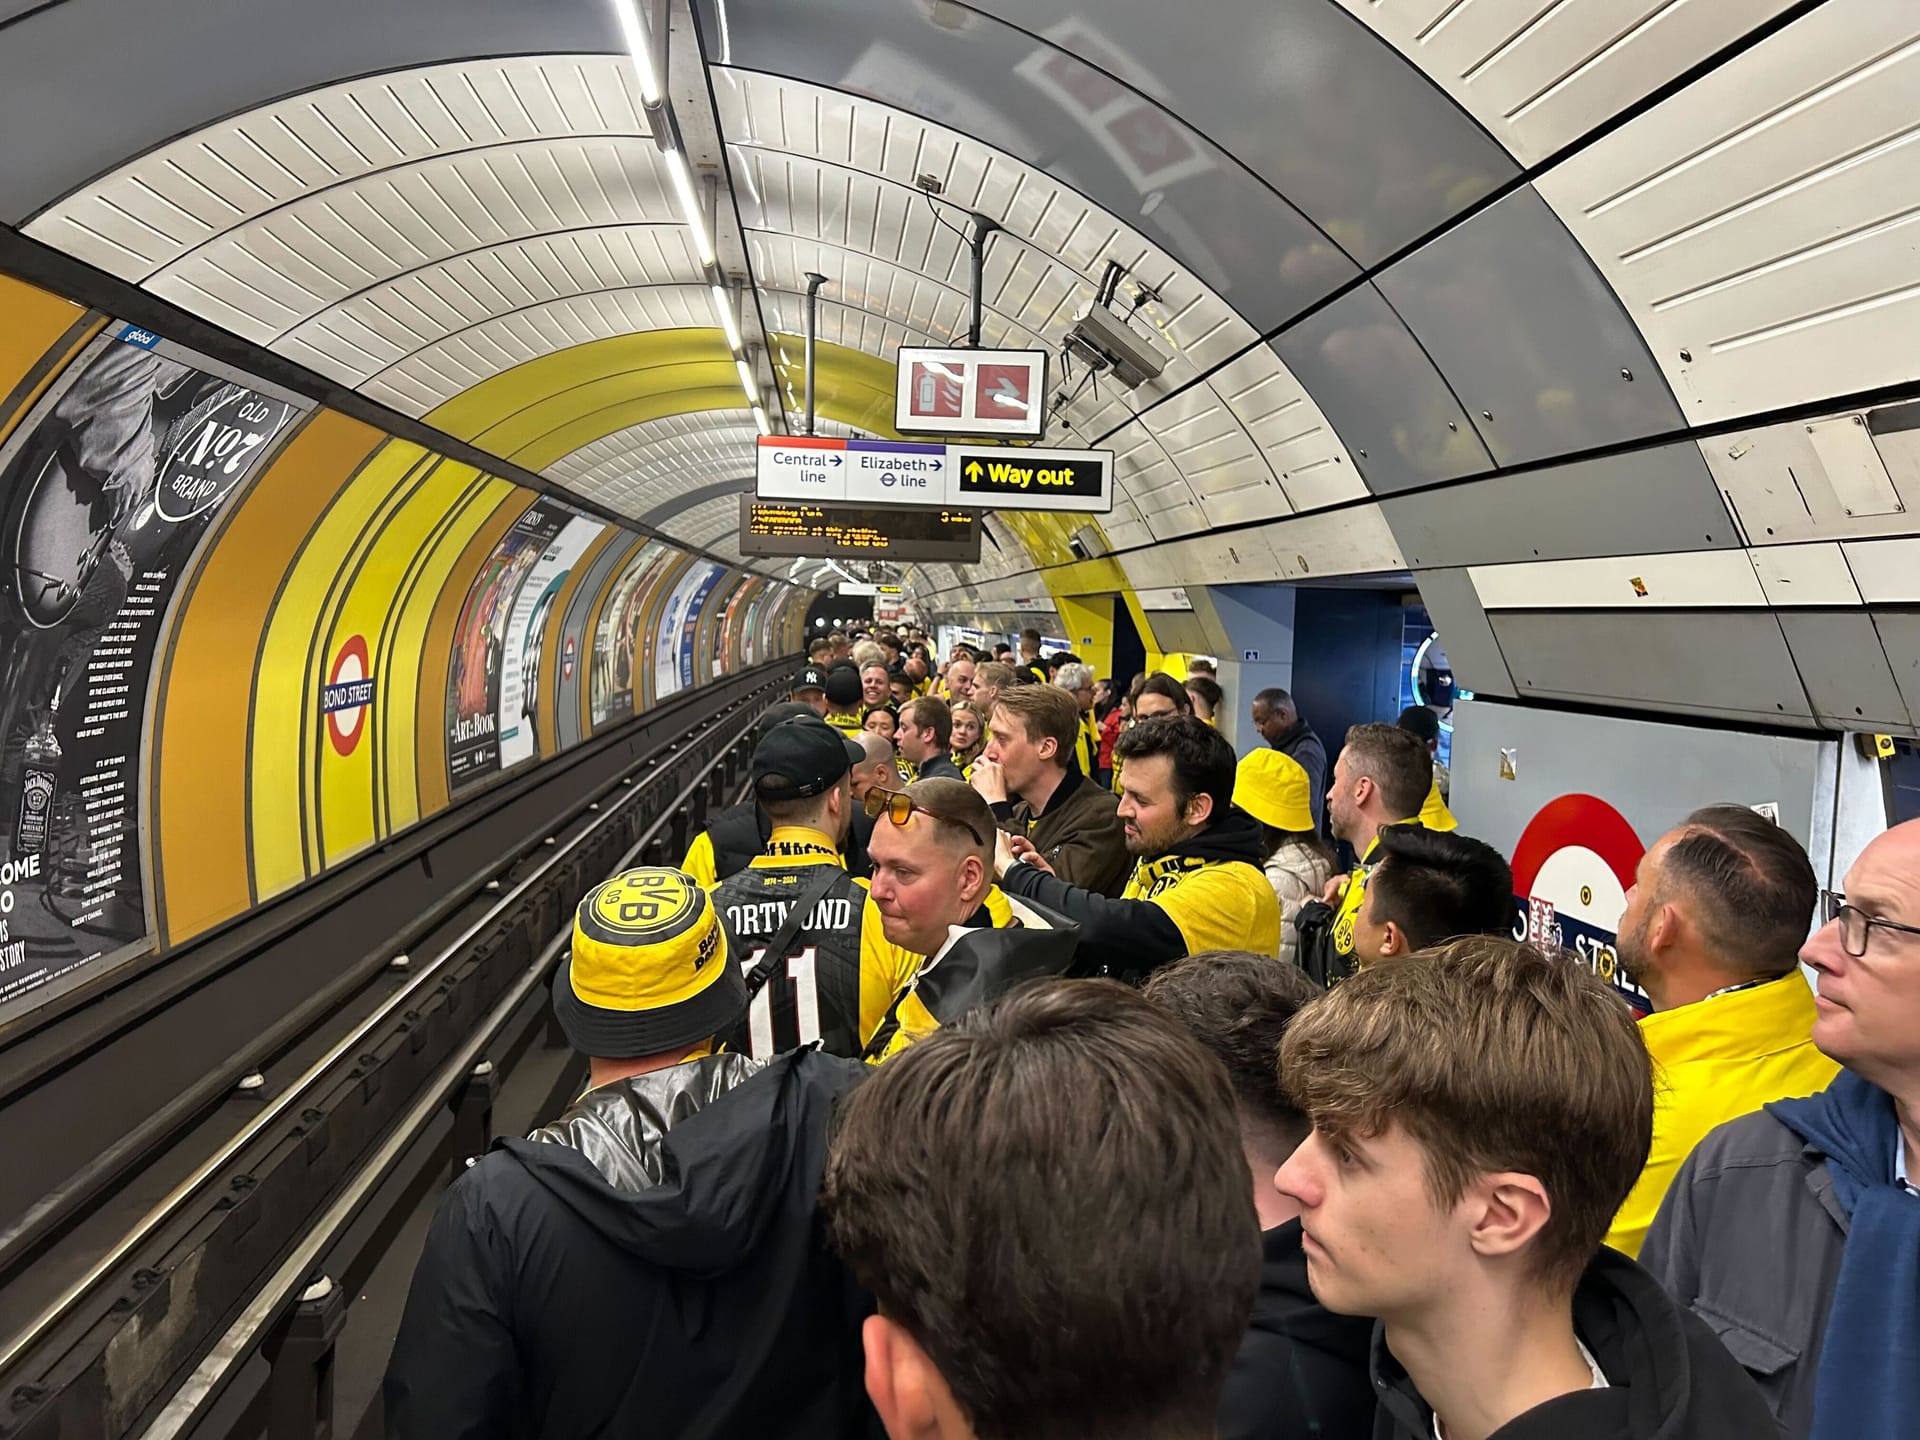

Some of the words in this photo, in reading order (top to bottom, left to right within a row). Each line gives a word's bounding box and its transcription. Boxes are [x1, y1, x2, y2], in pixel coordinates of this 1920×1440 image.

[124, 328, 154, 344] global
[238, 402, 270, 423] OLD
[774, 452, 826, 466] Central
[861, 457, 926, 471] Elizabeth
[172, 474, 217, 500] BRAND
[800, 470, 826, 482] line
[901, 474, 926, 487] line
[988, 464, 1033, 488] Way
[1037, 468, 1074, 486] out
[324, 688, 346, 708] BOND
[348, 683, 372, 704] STREET
[474, 712, 494, 737] BOOK
[0, 853, 40, 885] OME
[782, 876, 797, 884] 2024
[0, 890, 14, 913] O
[619, 876, 680, 921] BVB
[727, 899, 850, 935] ORTMUND
[0, 940, 25, 972] STORY
[740, 946, 820, 1060] 11
